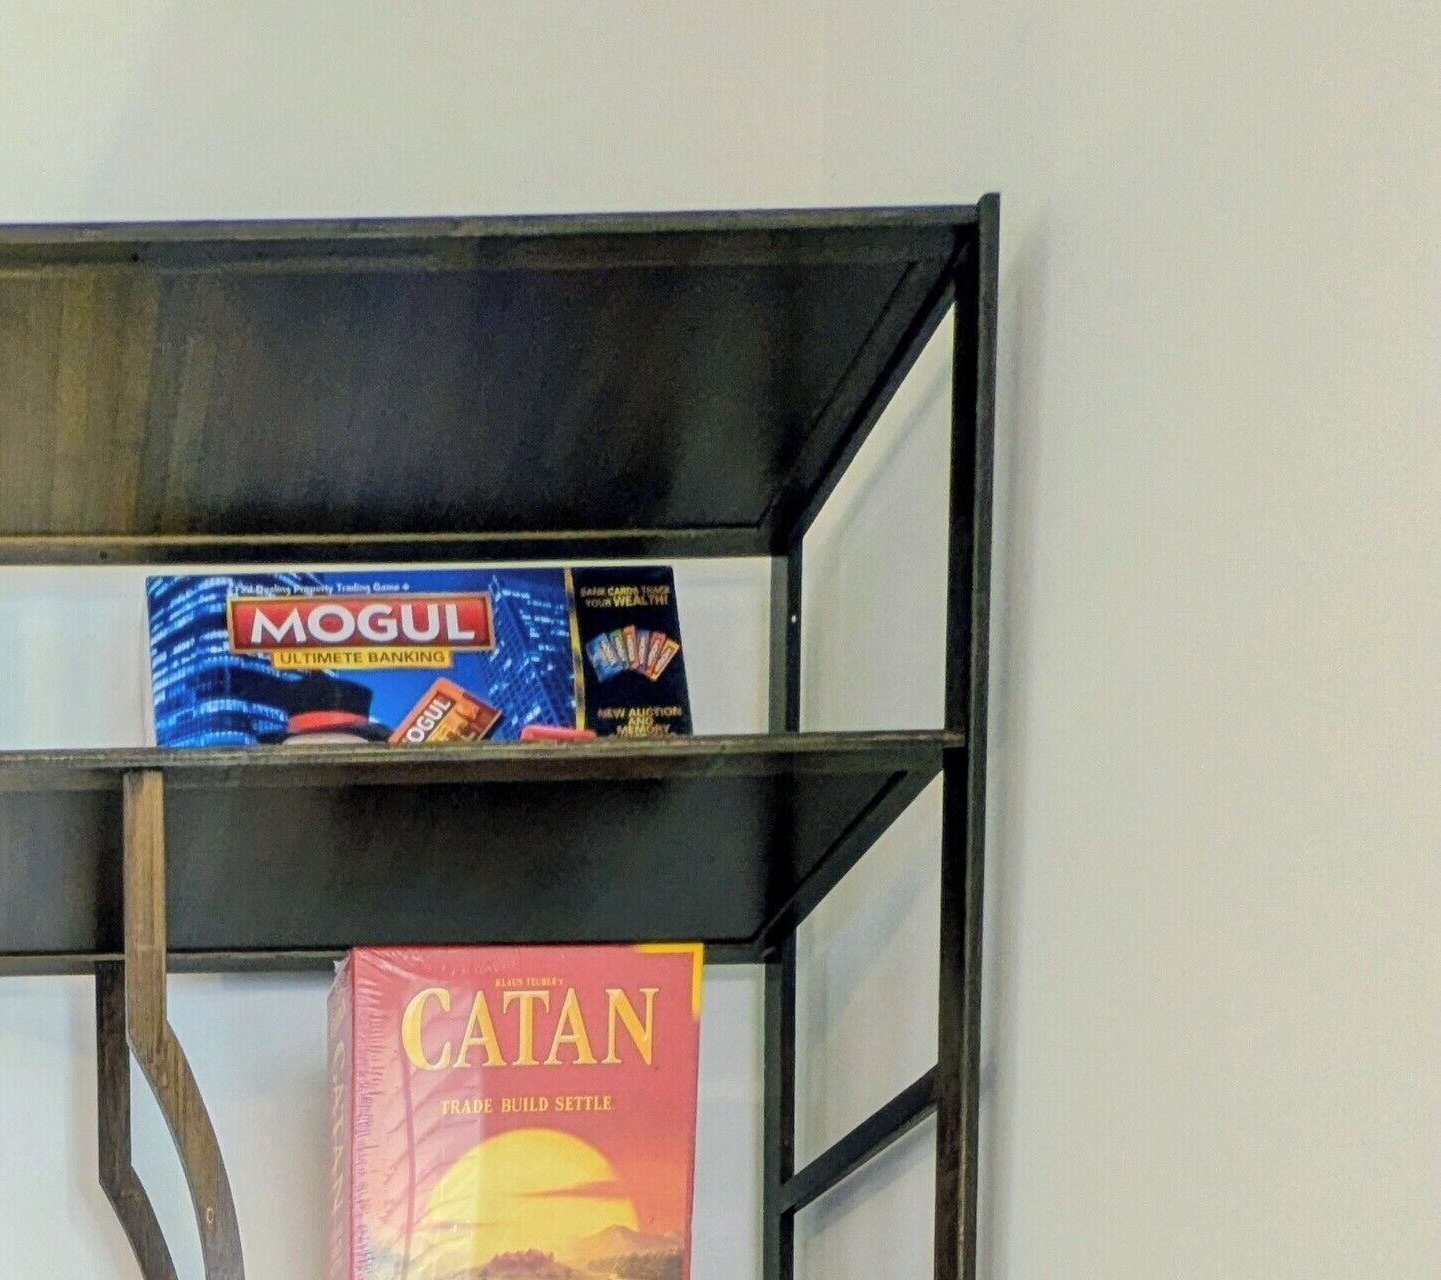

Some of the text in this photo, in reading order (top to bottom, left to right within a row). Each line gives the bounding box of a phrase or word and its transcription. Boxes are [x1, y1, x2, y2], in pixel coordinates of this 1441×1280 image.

[337, 581, 370, 594] Trading
[373, 581, 399, 591] Game
[250, 603, 475, 644] MOGUL
[368, 650, 445, 664] BANKING
[402, 699, 451, 742] OGUL
[597, 706, 682, 719] NEW AUCTION
[627, 717, 654, 727] AND
[401, 987, 660, 1070] CATAN
[440, 1095, 612, 1115] TRADE BUILD SETTLE
